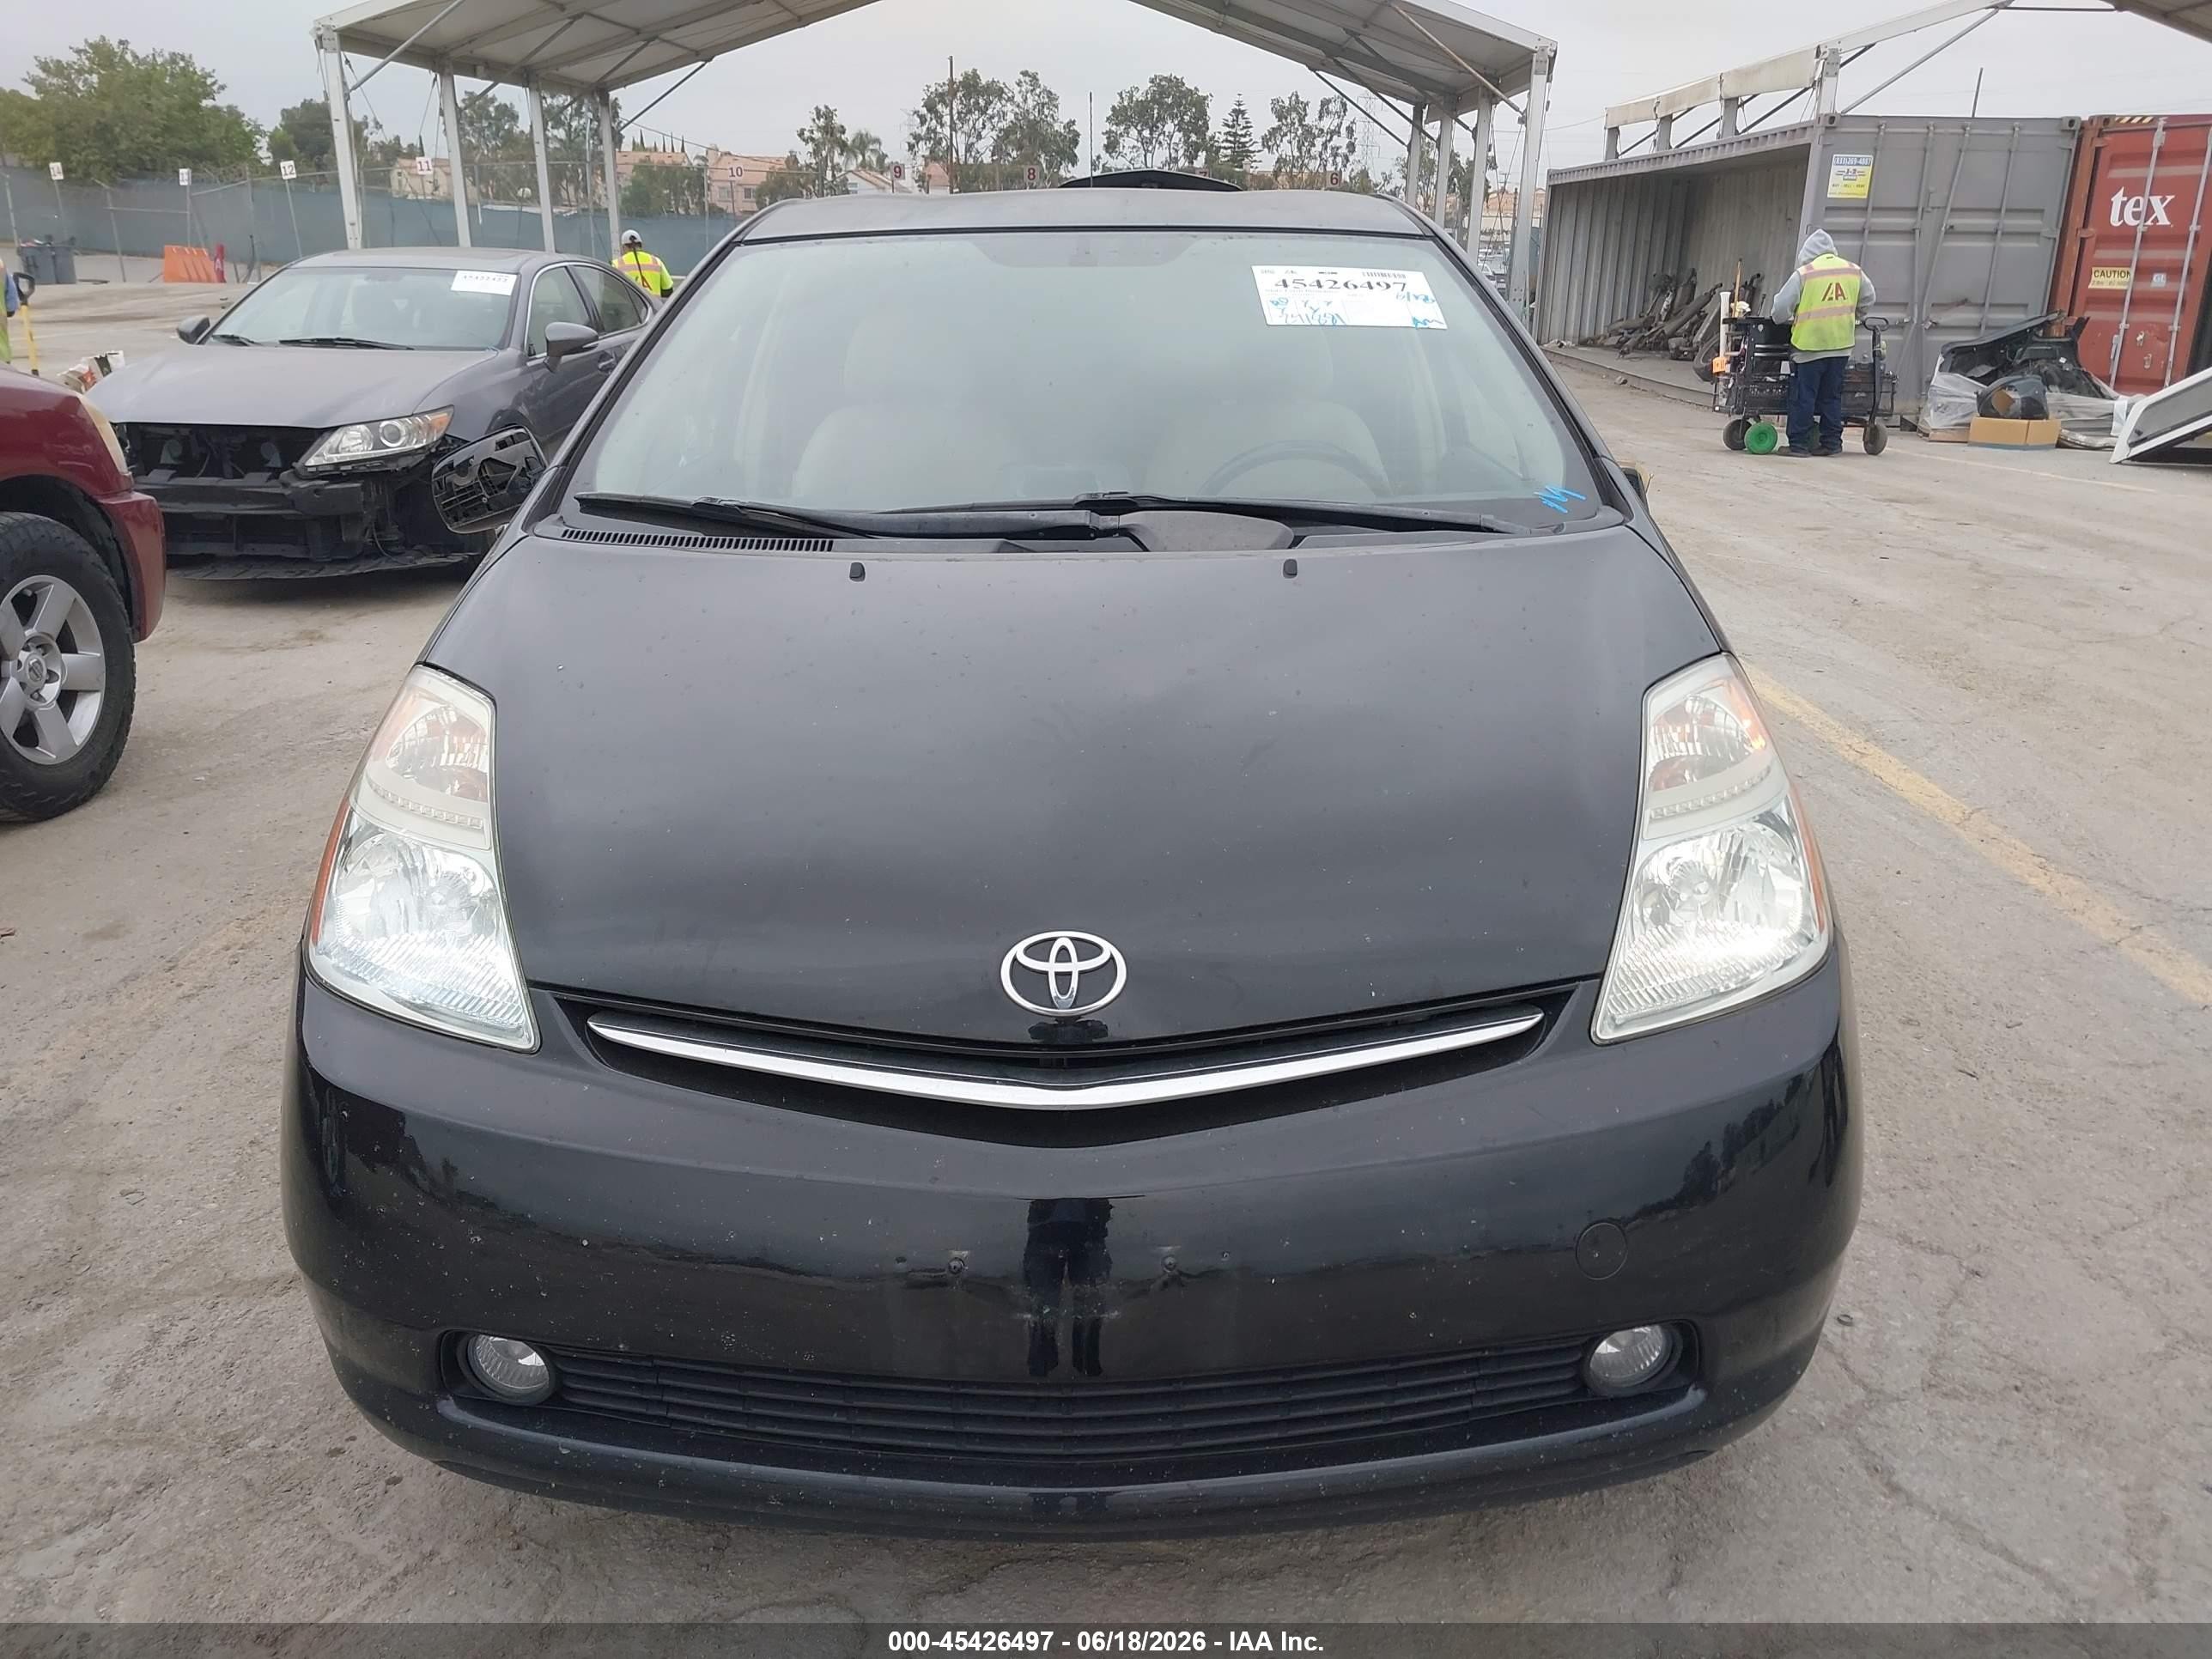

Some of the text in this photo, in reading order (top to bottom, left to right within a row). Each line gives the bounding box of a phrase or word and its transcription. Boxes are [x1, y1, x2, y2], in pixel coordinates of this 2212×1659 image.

[283, 164, 295, 176] 12
[418, 161, 431, 172] 11
[729, 167, 743, 178] 10
[893, 165, 902, 179] 9
[1027, 167, 1036, 180] 8
[1330, 172, 1339, 185] 6
[2110, 185, 2175, 227] tex
[1274, 278, 1407, 292] 45426497
